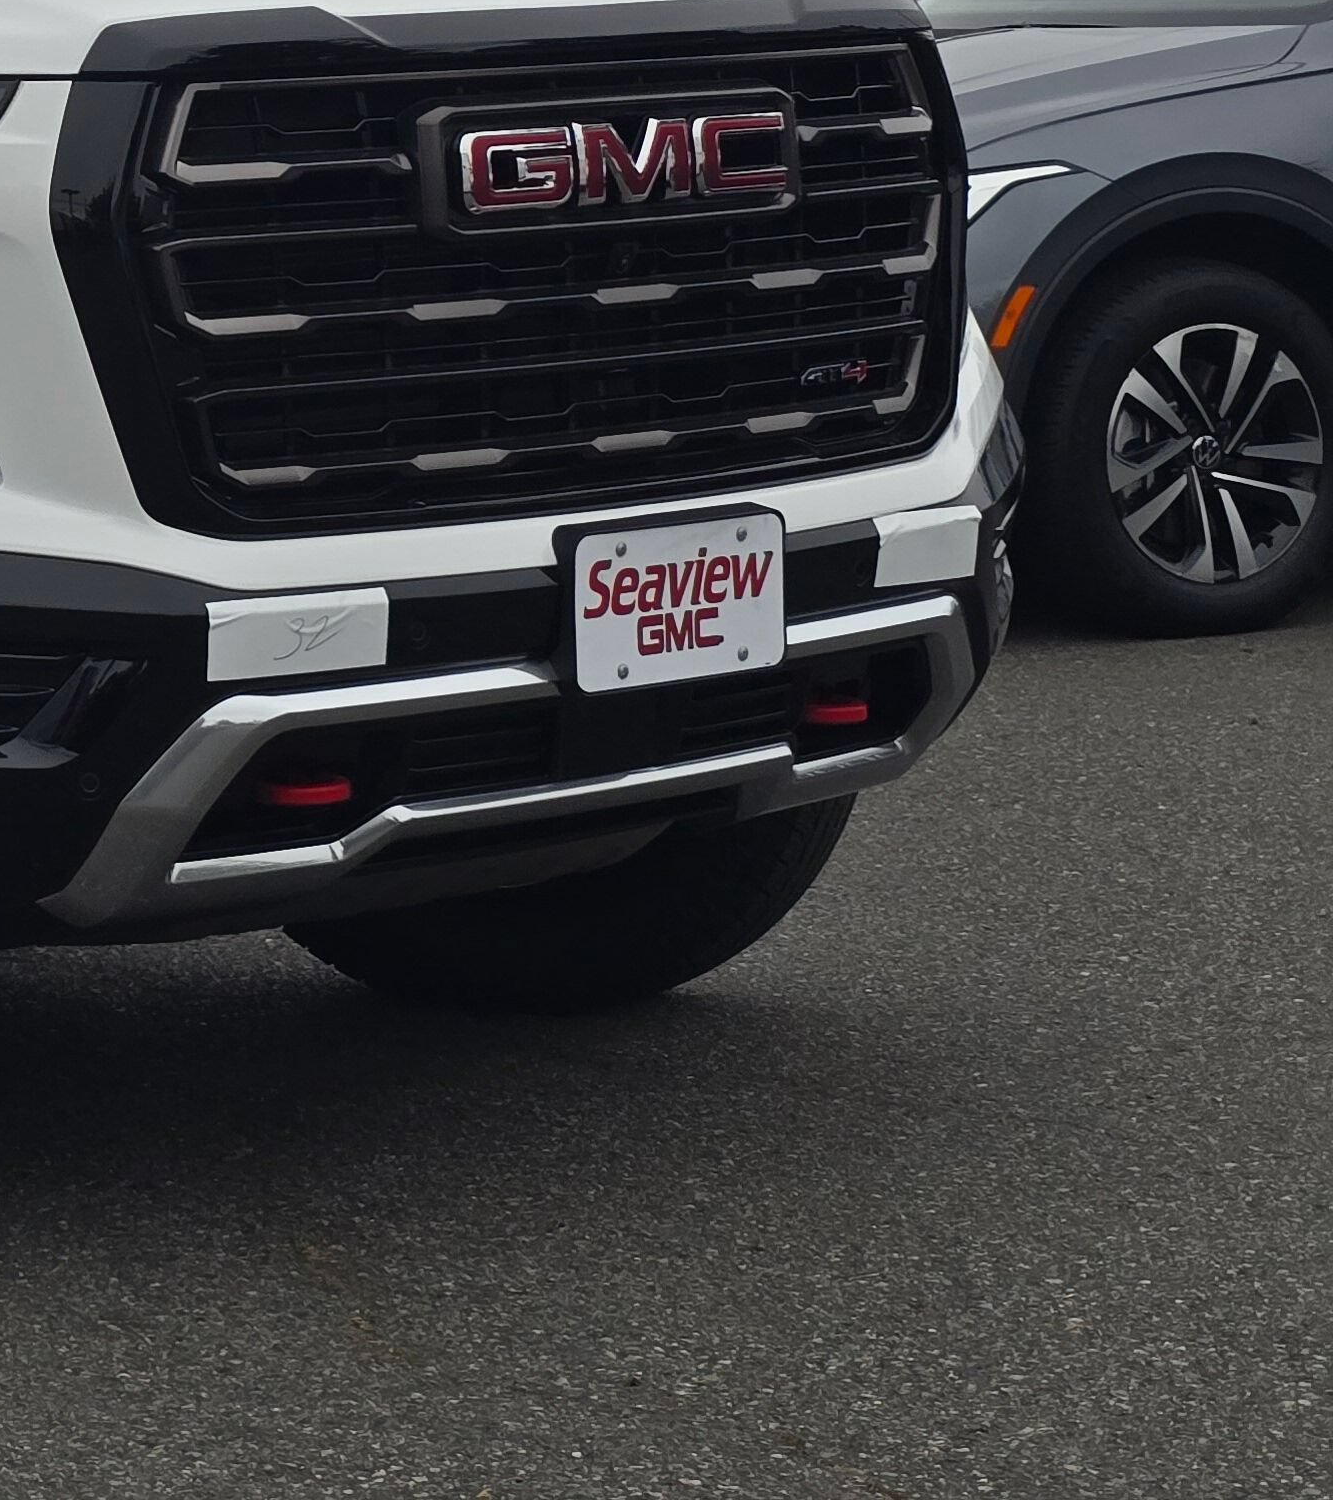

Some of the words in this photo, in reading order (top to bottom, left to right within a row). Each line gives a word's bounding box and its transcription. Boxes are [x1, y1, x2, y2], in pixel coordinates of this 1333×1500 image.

[459, 110, 789, 214] GMC
[800, 360, 869, 387] AT4
[583, 546, 774, 620] Seaview
[272, 614, 344, 661] 32
[636, 606, 724, 657] GMC
